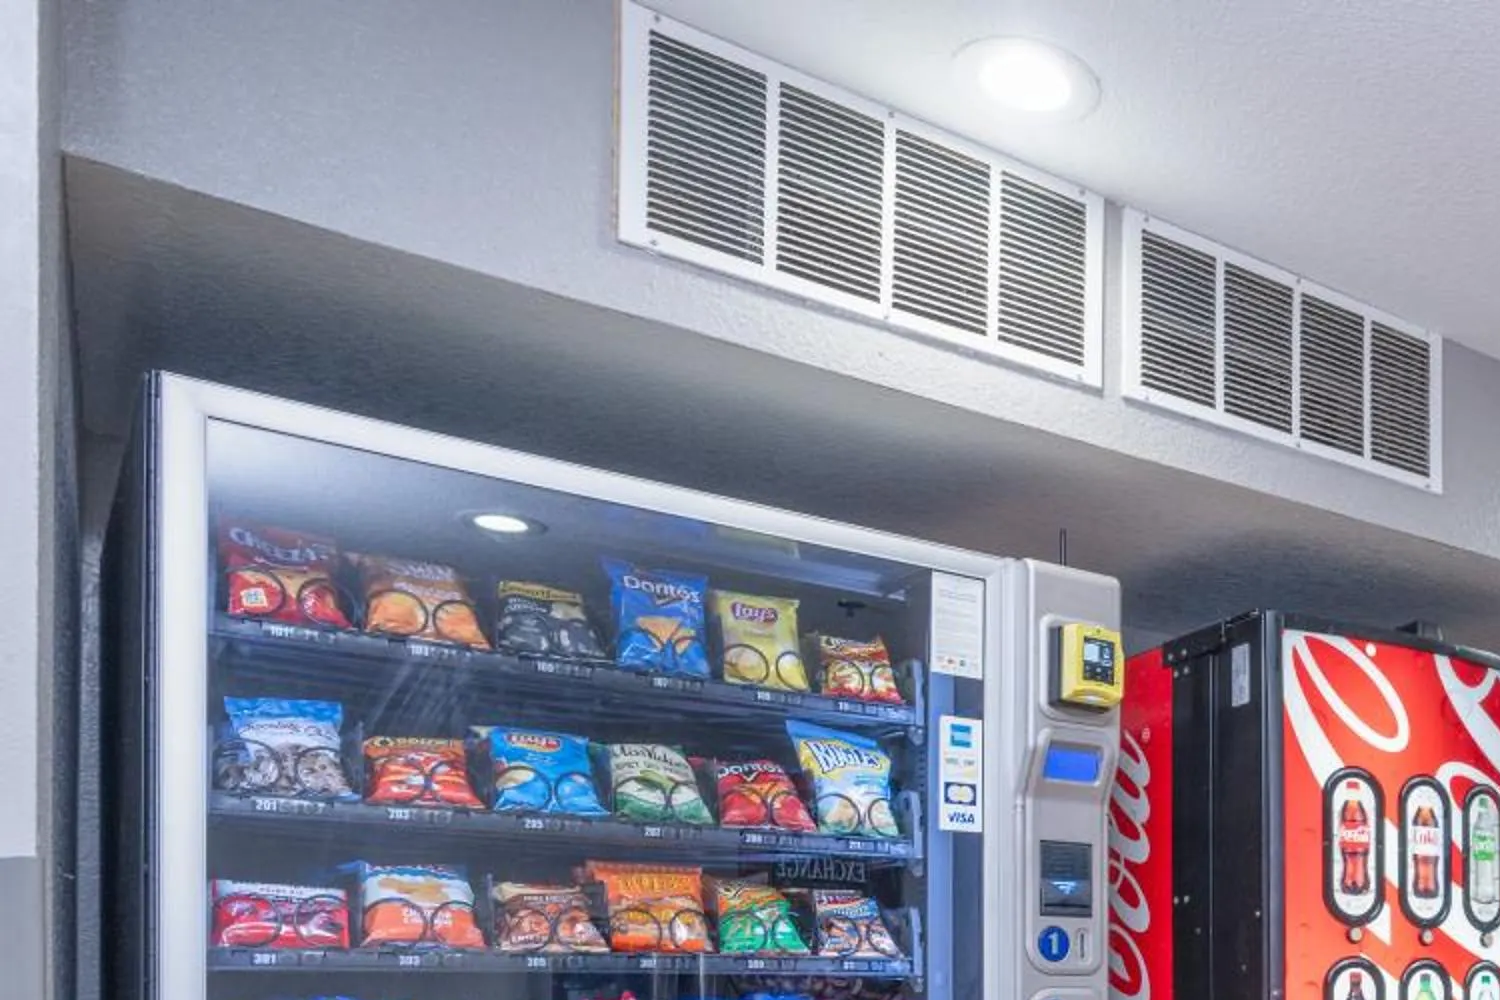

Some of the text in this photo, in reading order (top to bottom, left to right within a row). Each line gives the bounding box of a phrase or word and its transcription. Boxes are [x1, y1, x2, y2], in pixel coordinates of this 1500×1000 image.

[623, 575, 701, 604] Doritos
[255, 799, 277, 811] 201
[948, 809, 975, 825] VISA
[1048, 931, 1060, 955] 1
